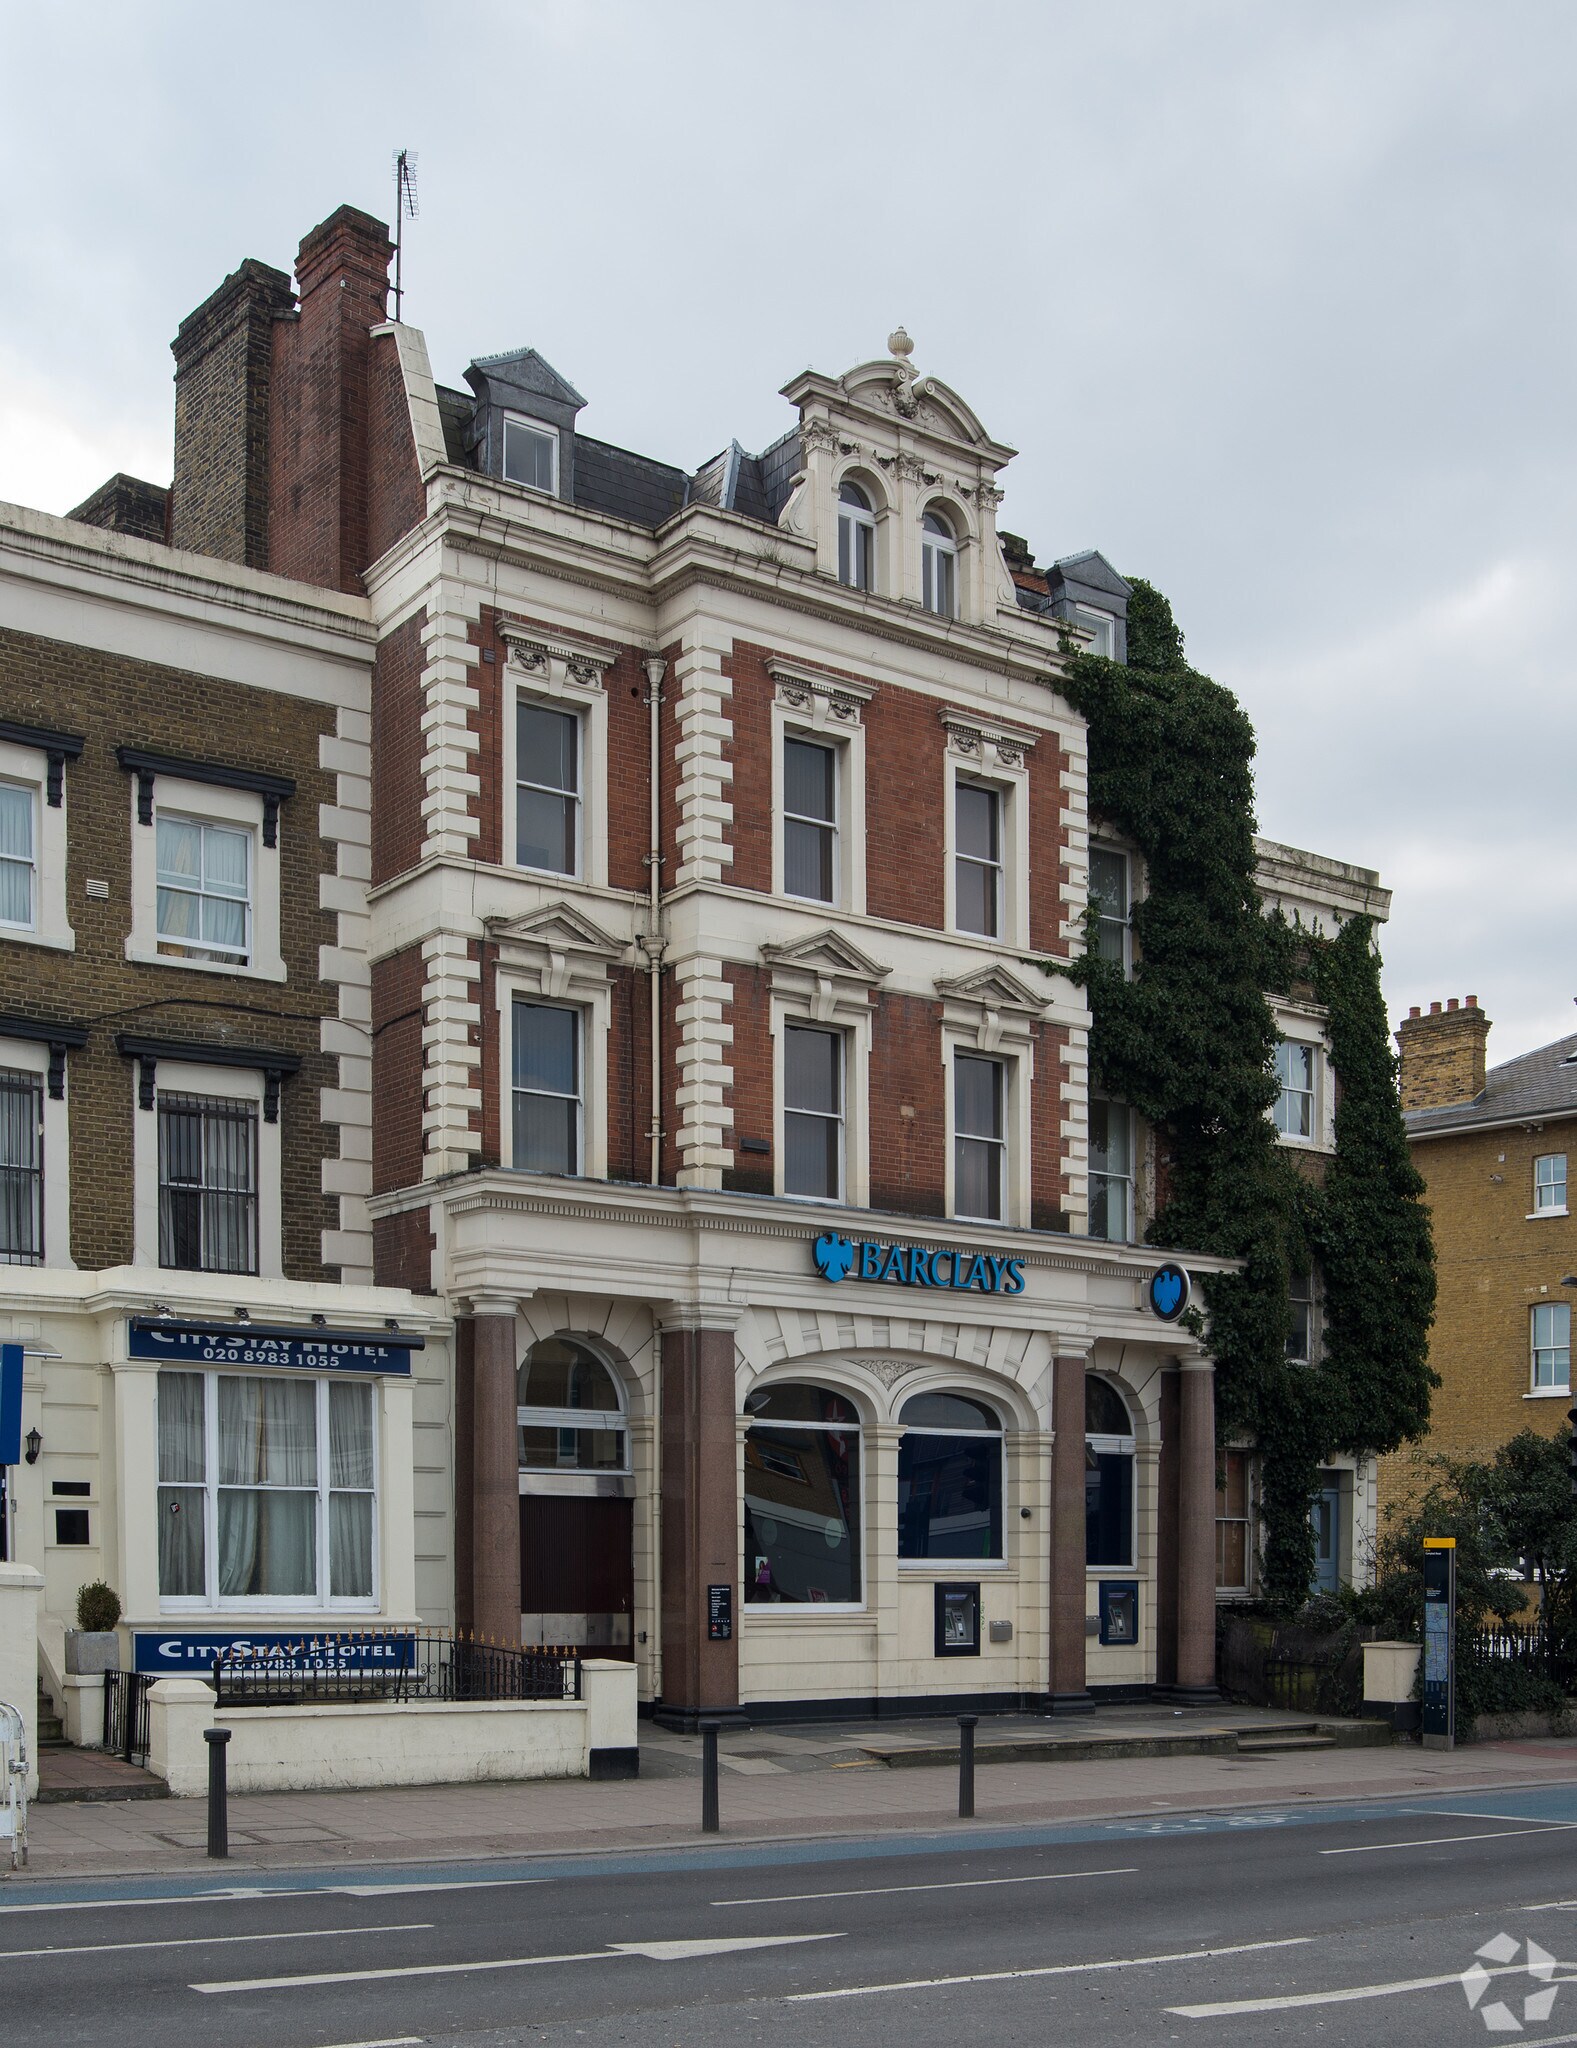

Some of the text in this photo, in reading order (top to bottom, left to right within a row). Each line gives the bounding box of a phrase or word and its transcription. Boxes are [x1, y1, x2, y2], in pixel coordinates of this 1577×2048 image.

[859, 1242, 1026, 1294] BARCLAYS
[203, 1347, 339, 1367] 020 8983 1055
[310, 1641, 396, 1657] HOTEL
[303, 1658, 347, 1669] 1055
